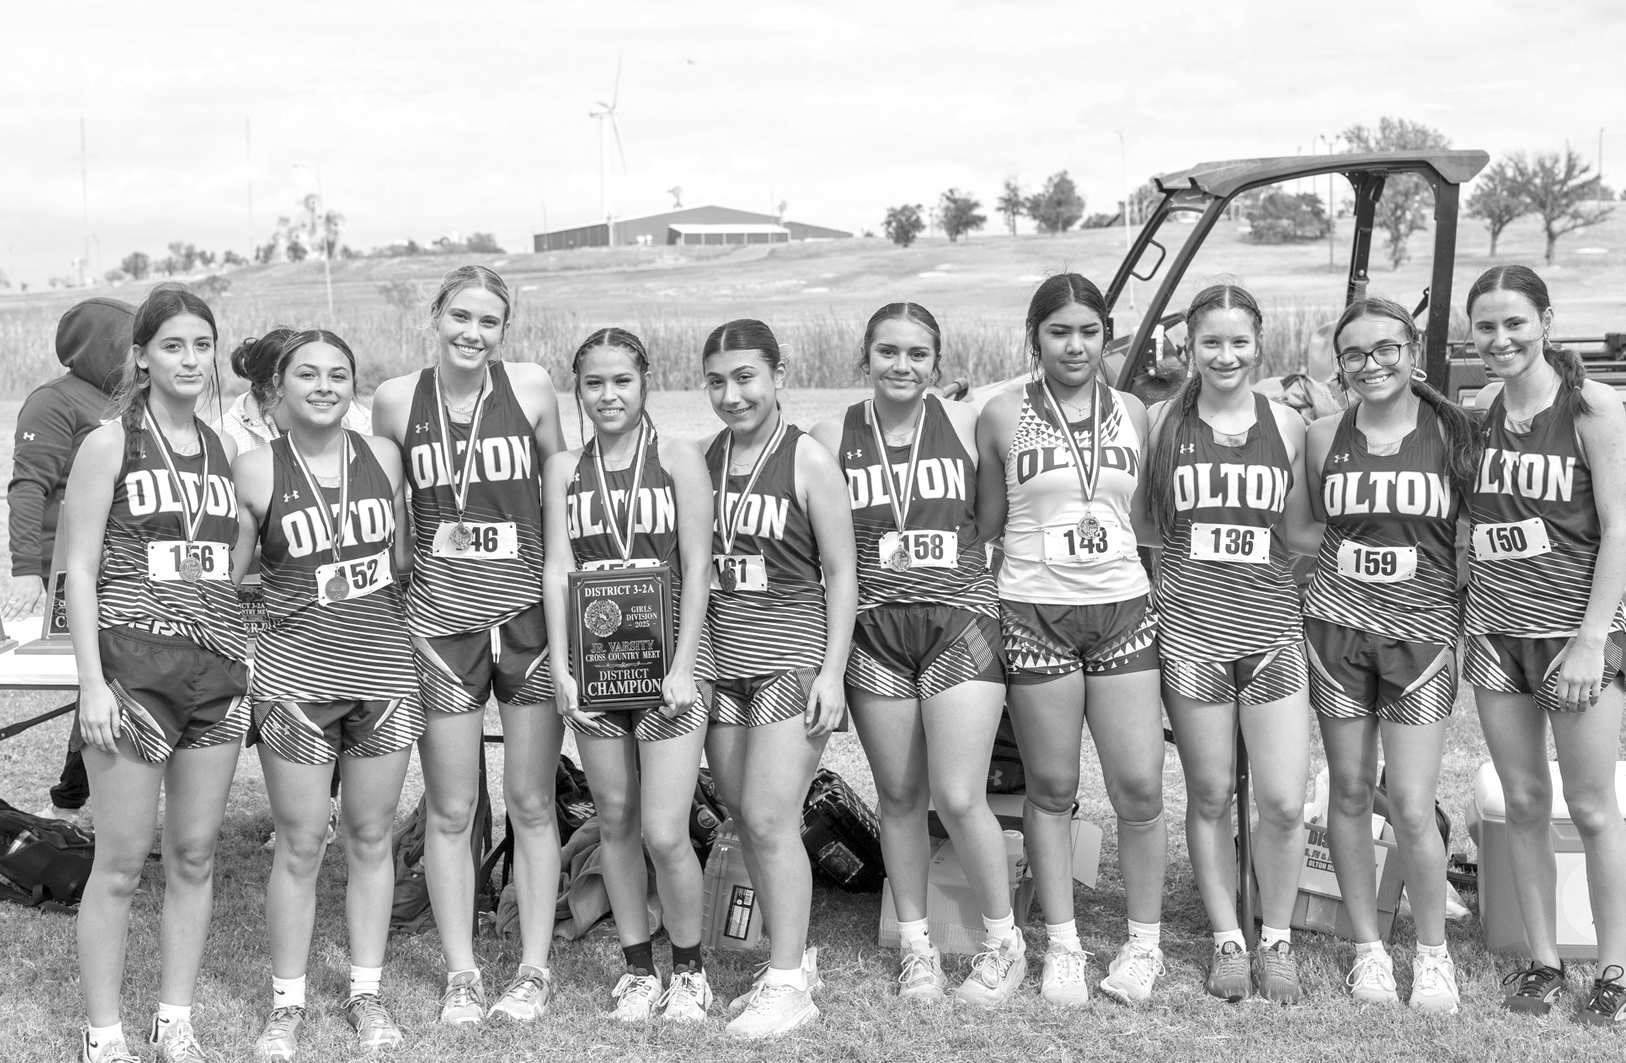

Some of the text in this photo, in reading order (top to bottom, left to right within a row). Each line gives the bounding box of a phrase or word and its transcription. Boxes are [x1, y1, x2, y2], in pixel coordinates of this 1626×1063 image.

[846, 457, 966, 510] OLTON
[1173, 462, 1288, 513] OLTON
[1473, 447, 1576, 502] LTON
[1324, 470, 1451, 520] OLTON
[281, 497, 396, 559] OLTON
[456, 526, 498, 552] 46
[1063, 526, 1109, 556] 143
[1210, 527, 1255, 556] 136
[1486, 525, 1528, 553] 150
[900, 533, 944, 560] 158
[1353, 548, 1397, 576] 159
[584, 583, 655, 598] DISTRICT 3-2A
[626, 612, 658, 621] DIVISION
[630, 605, 653, 613] GIRLS
[585, 650, 661, 662] CROSS COUNTRY MEET
[591, 639, 654, 654] JR. VARSITY
[587, 678, 662, 697] CHAMPION
[600, 668, 649, 681] DISTRICT
